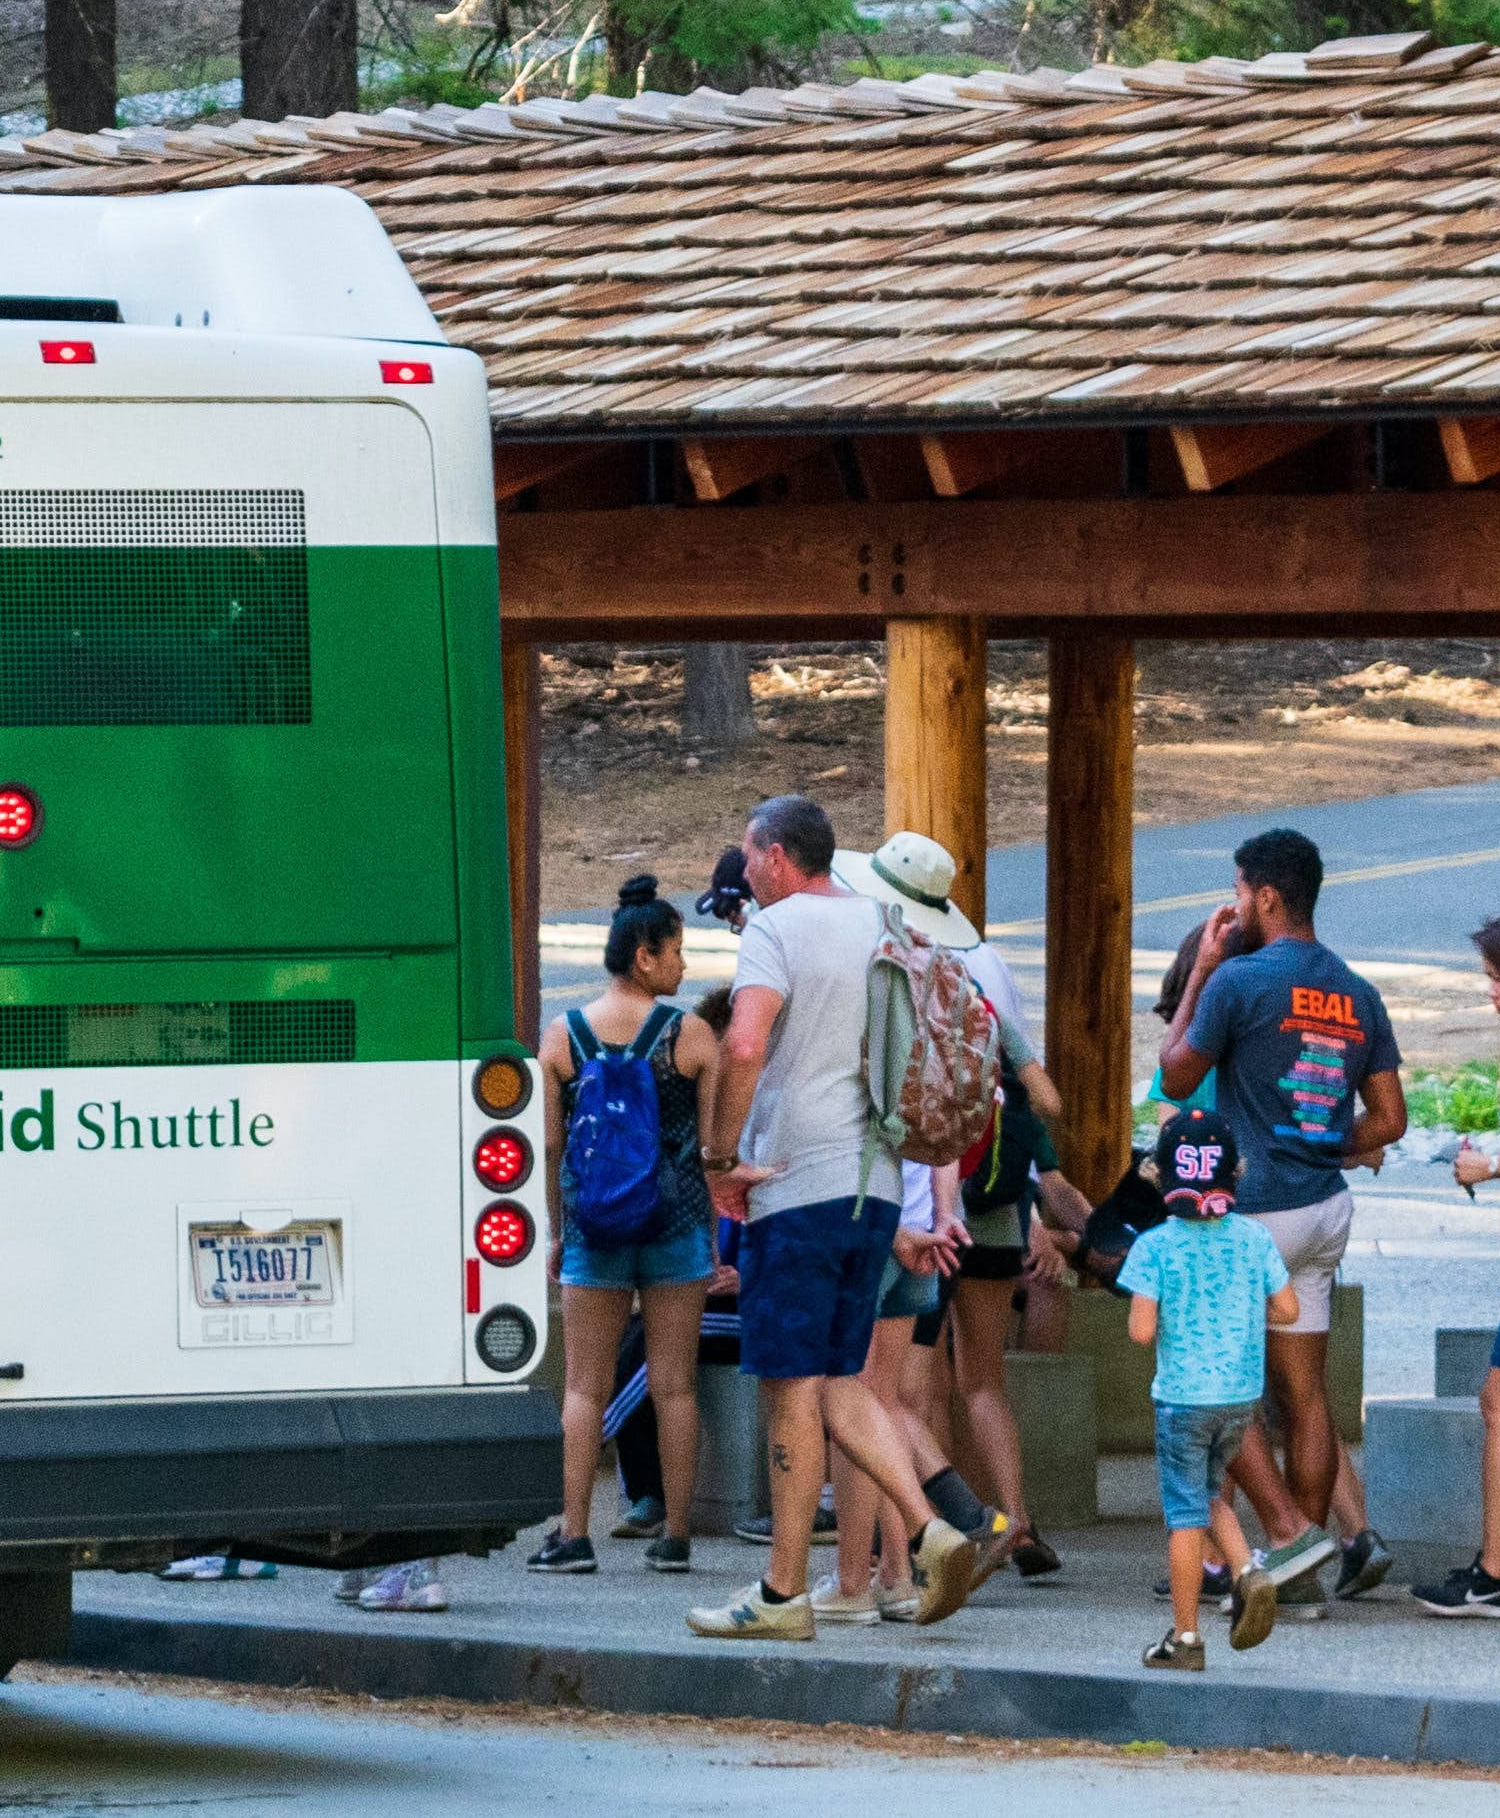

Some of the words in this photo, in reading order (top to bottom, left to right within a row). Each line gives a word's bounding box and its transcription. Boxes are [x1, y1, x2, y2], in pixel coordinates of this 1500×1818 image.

[1291, 986, 1359, 1026] EBAL
[77, 1097, 275, 1152] Shuttle
[1174, 1143, 1223, 1181] SF
[212, 1246, 313, 1283] I516077
[201, 1310, 332, 1342] GILLIG
